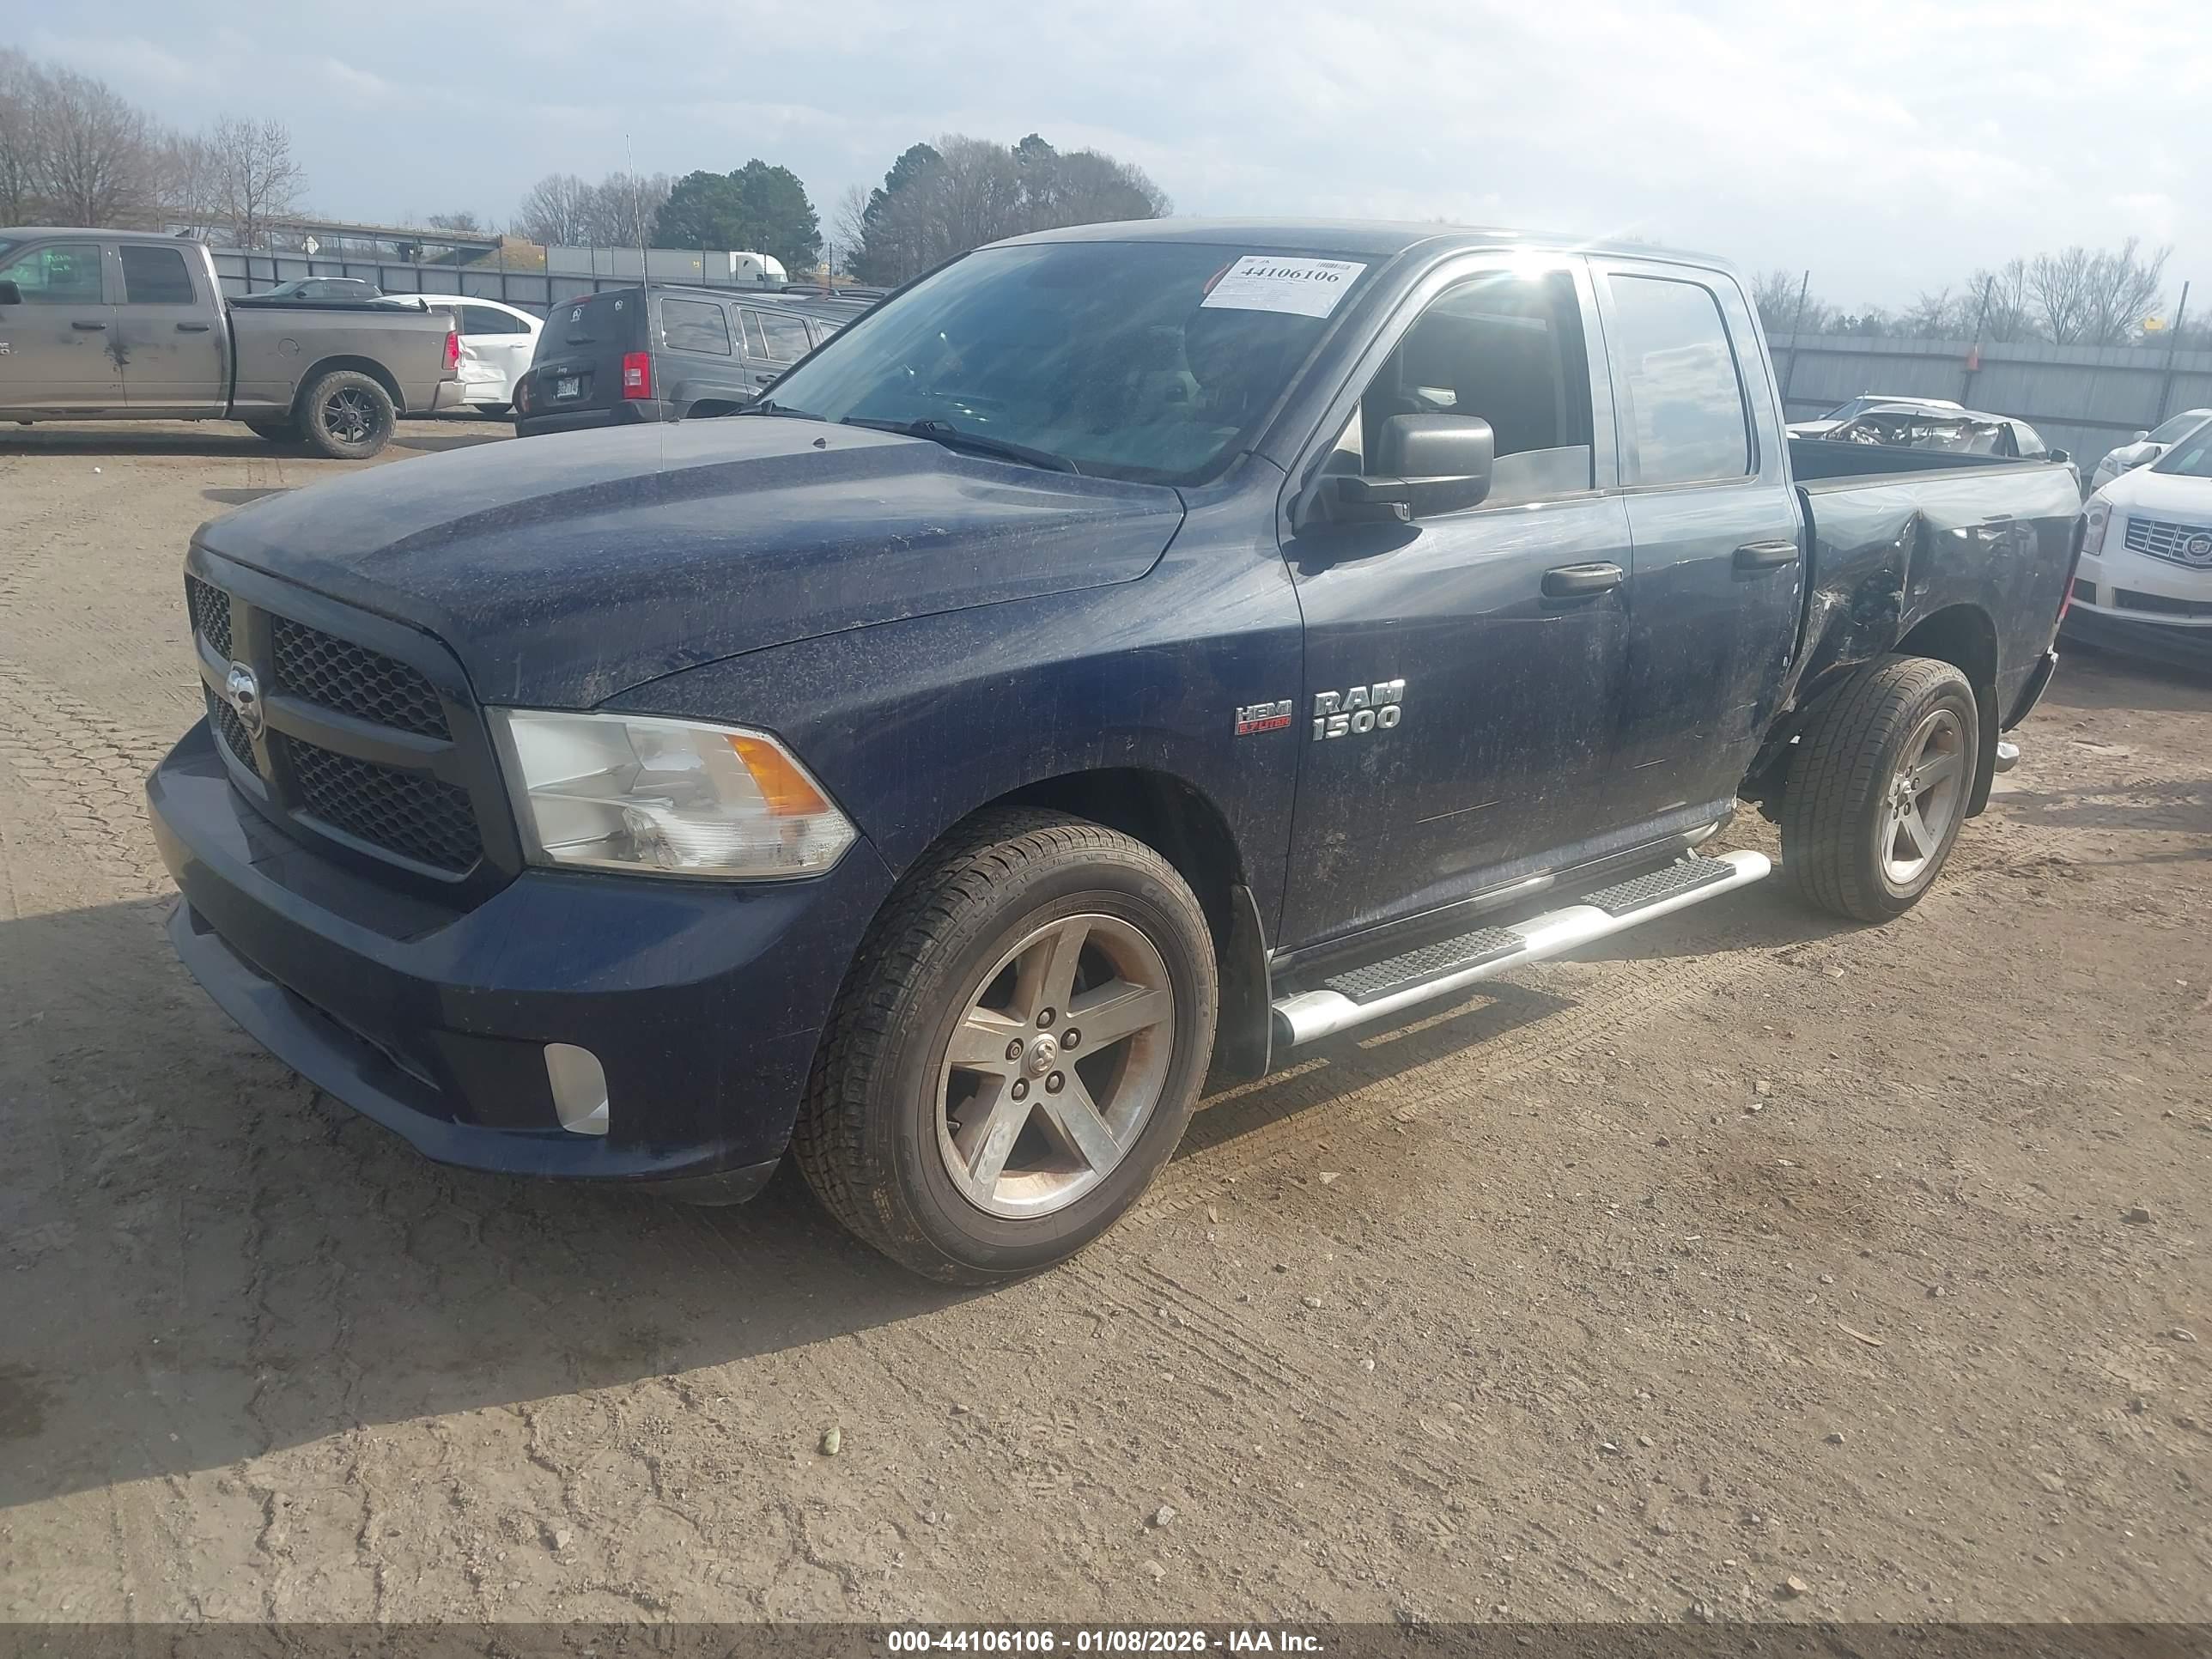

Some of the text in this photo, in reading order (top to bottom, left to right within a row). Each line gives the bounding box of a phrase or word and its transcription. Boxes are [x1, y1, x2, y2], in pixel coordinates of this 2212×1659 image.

[1241, 266, 1341, 283] 44106106
[1236, 699, 1292, 722] HEMI
[1313, 678, 1407, 716] RAM
[1312, 705, 1402, 742] 1500
